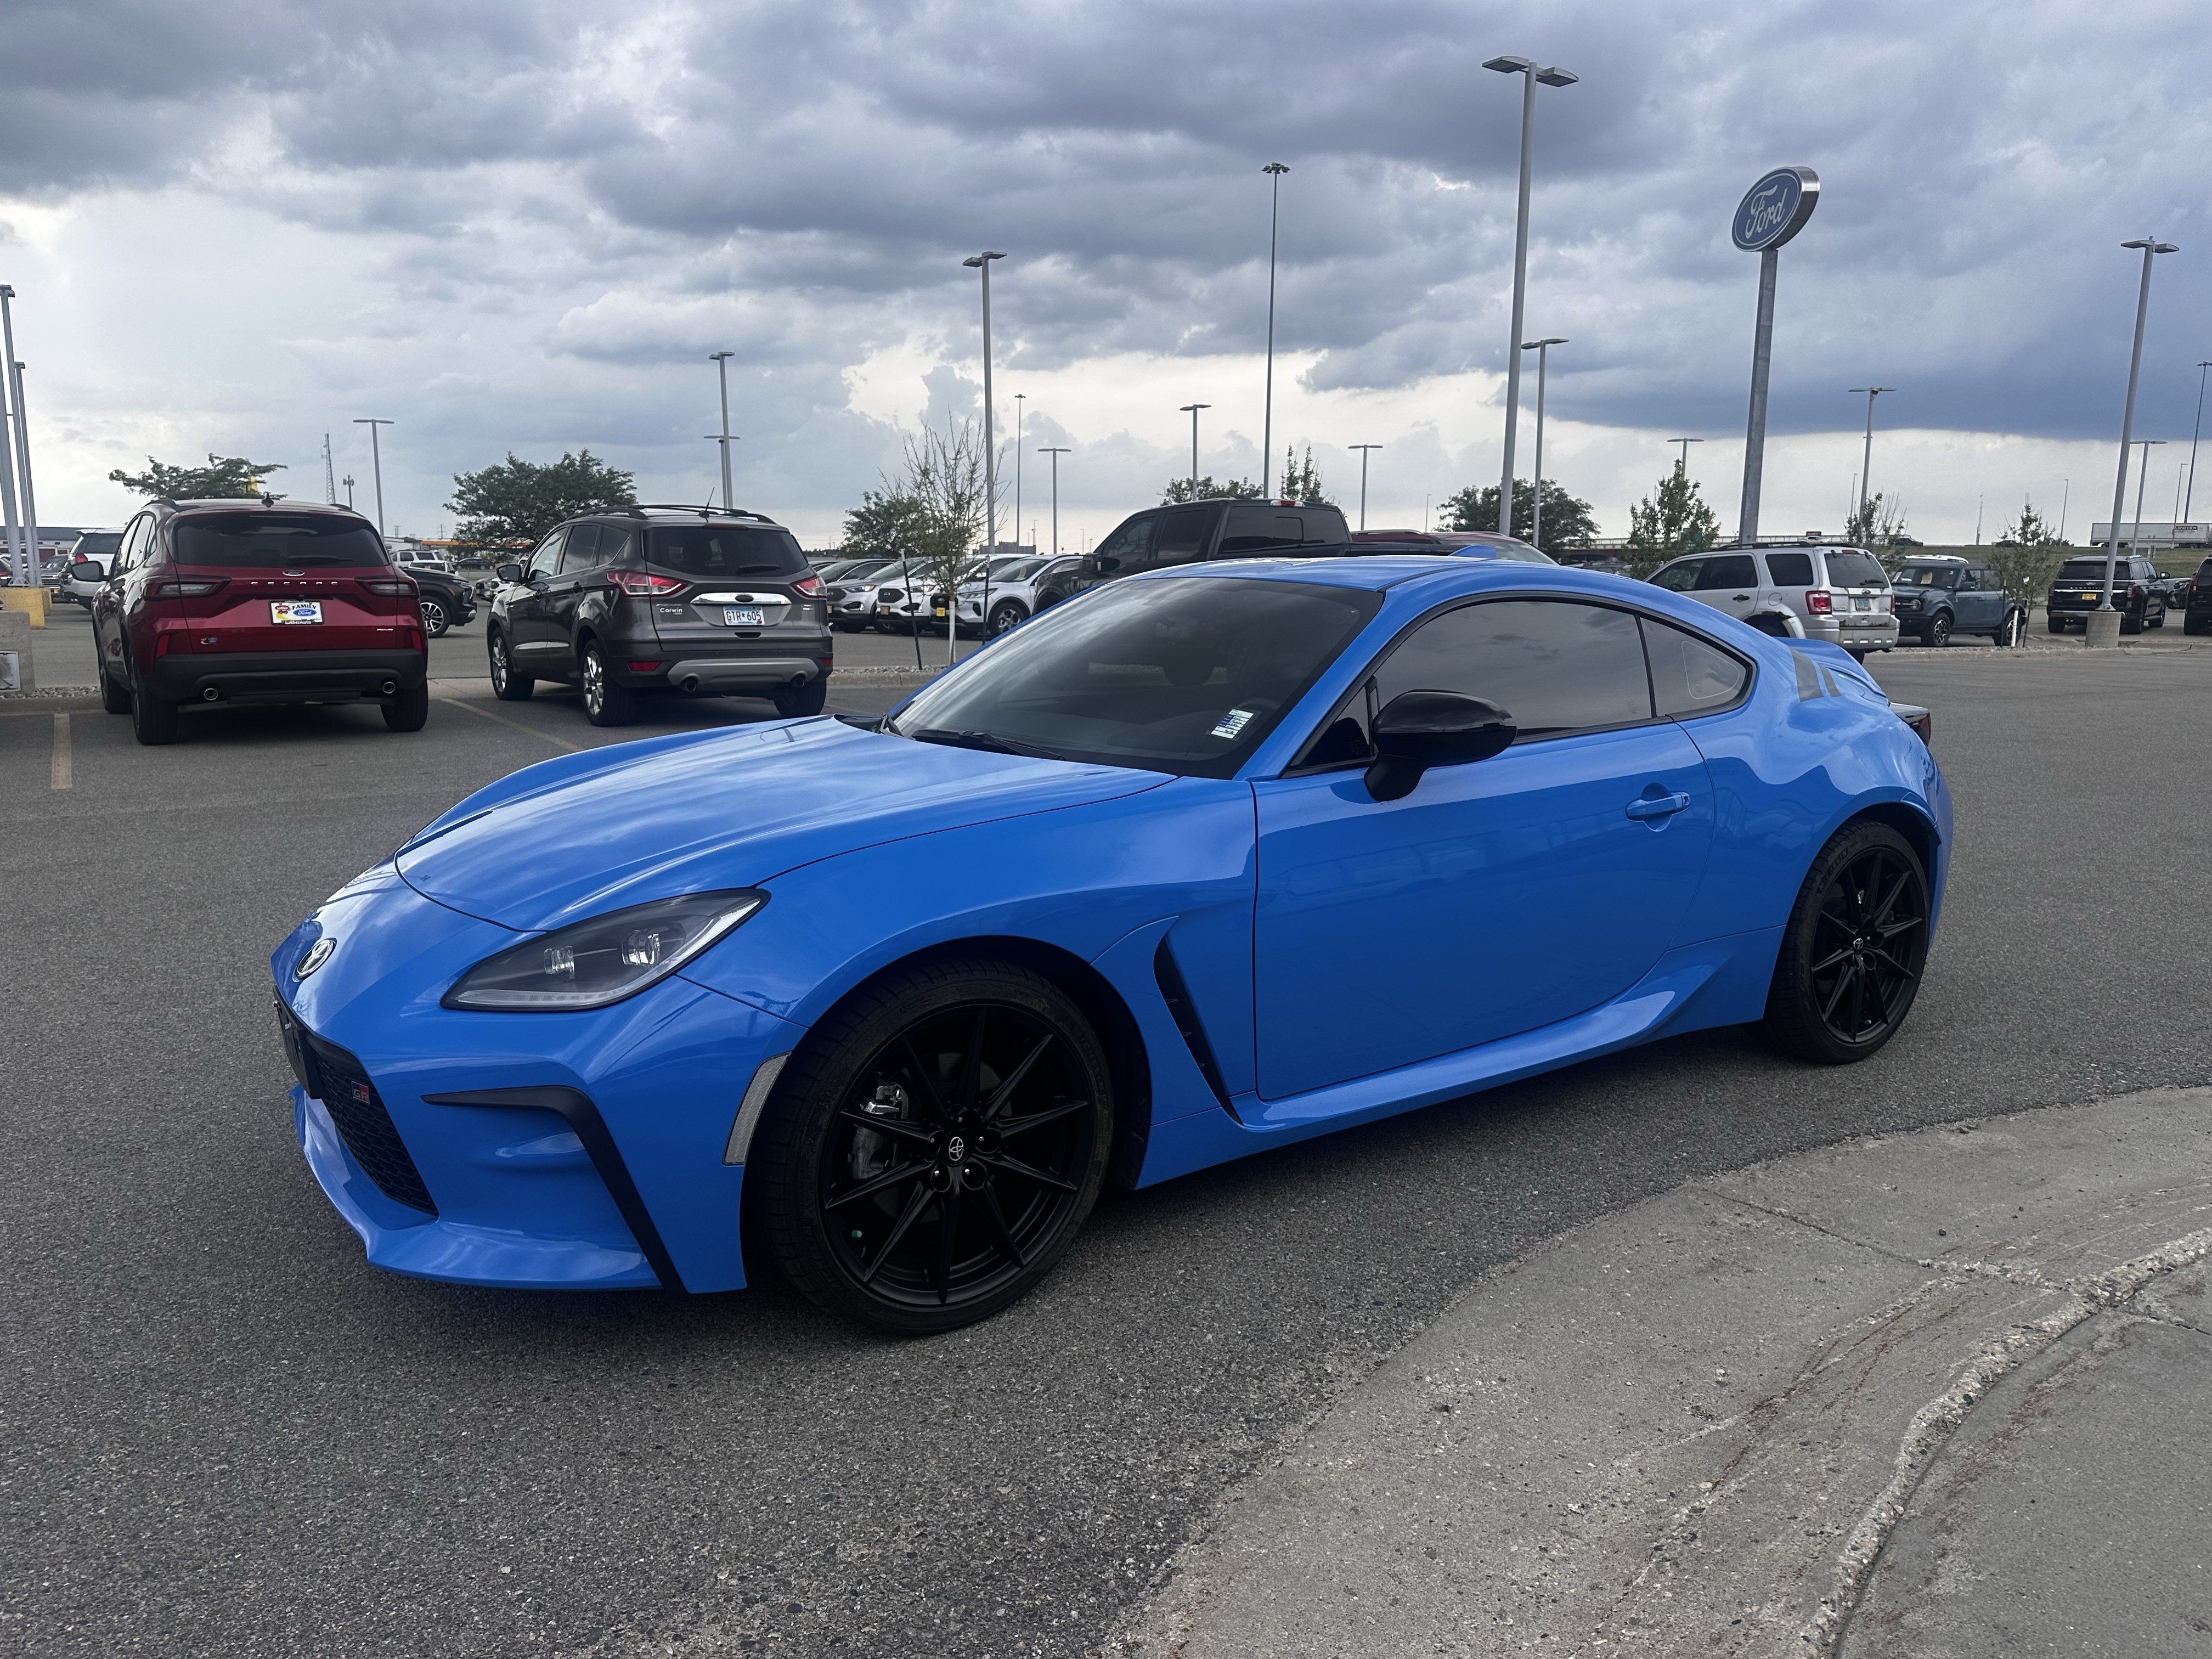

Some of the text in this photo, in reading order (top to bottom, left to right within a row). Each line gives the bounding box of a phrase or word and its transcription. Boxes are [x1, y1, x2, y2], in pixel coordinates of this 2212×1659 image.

[1745, 185, 1787, 239] Ford
[726, 611, 761, 621] GTR 605
[353, 1088, 369, 1103] GR
